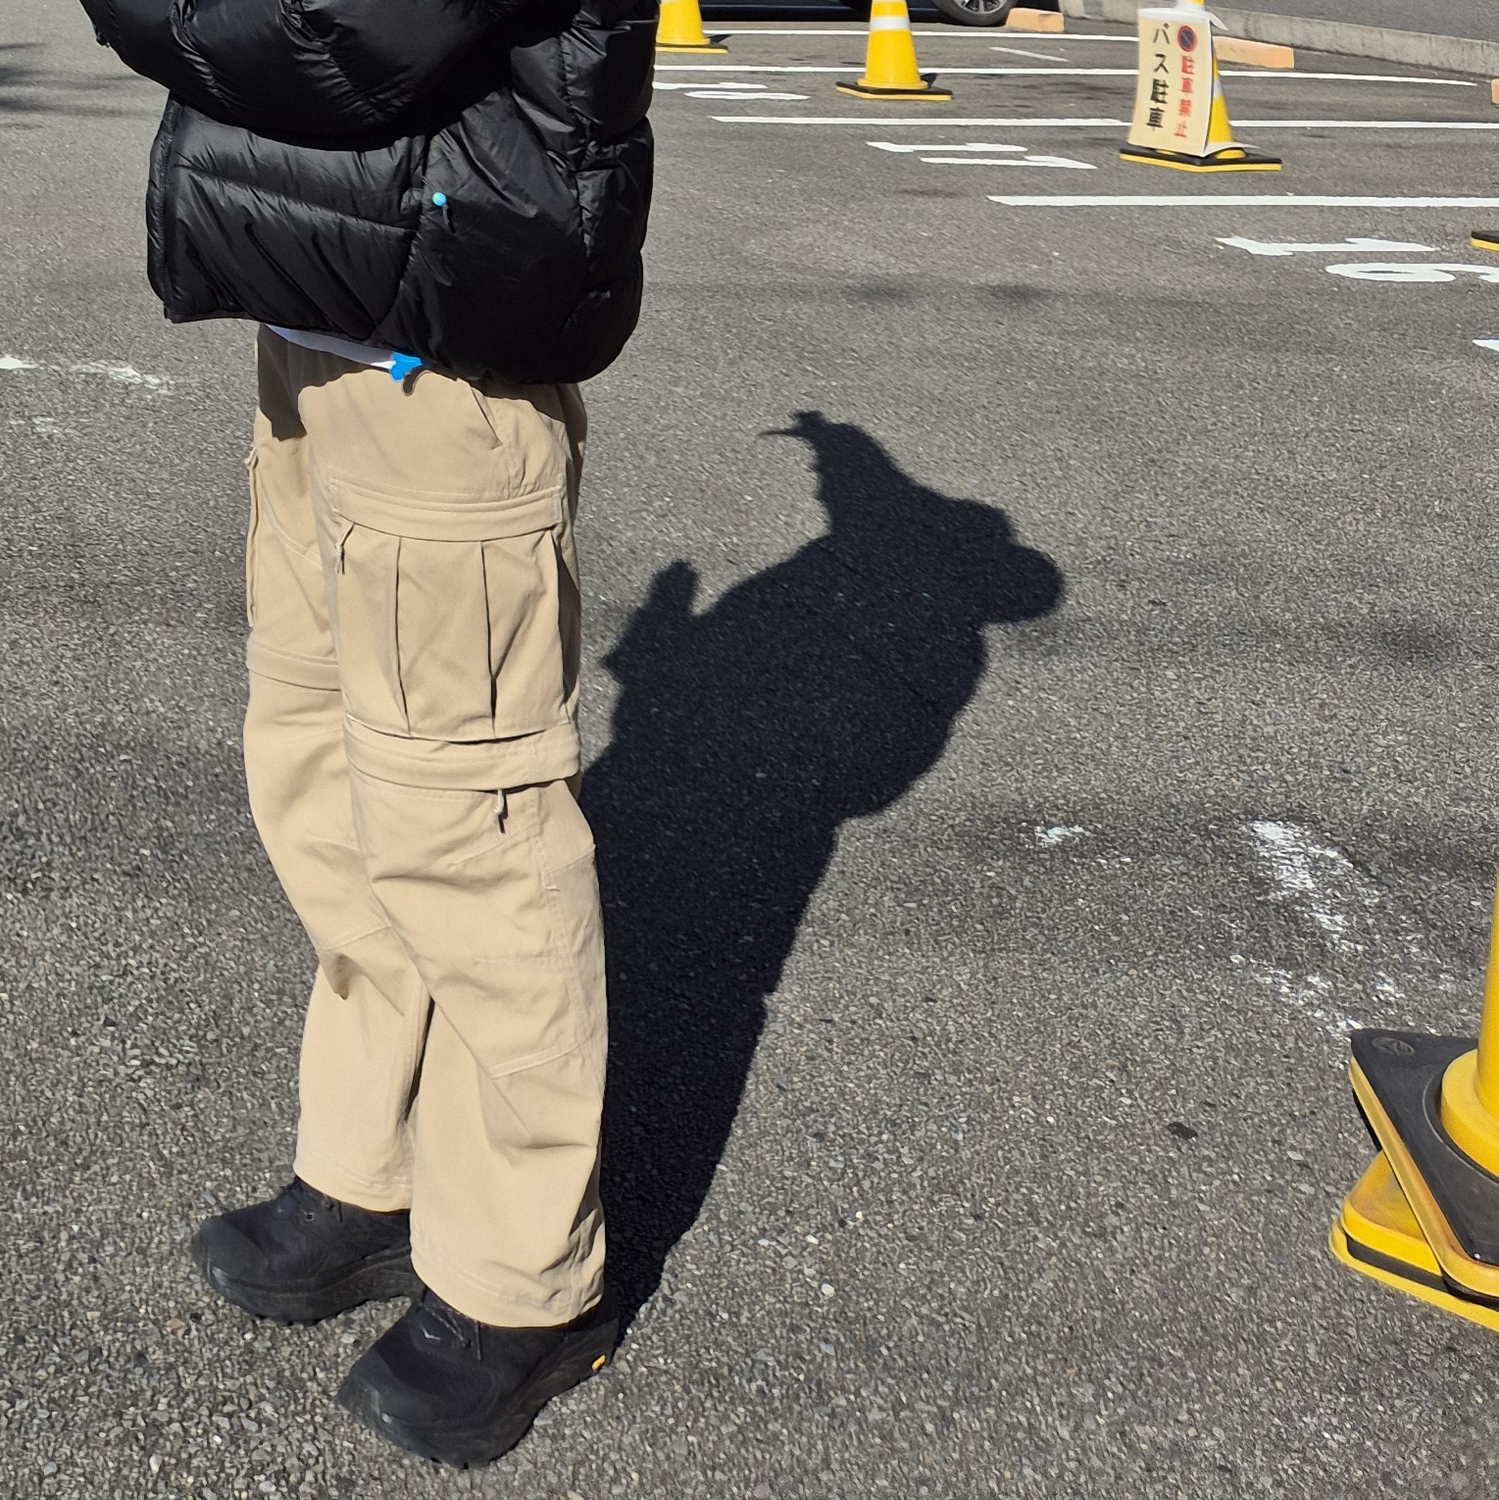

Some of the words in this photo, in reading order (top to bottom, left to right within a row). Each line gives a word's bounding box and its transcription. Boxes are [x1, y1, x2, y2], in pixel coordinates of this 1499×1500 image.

[1146, 22, 1171, 131] バス駐車
[1174, 55, 1195, 138] 駐車禁止
